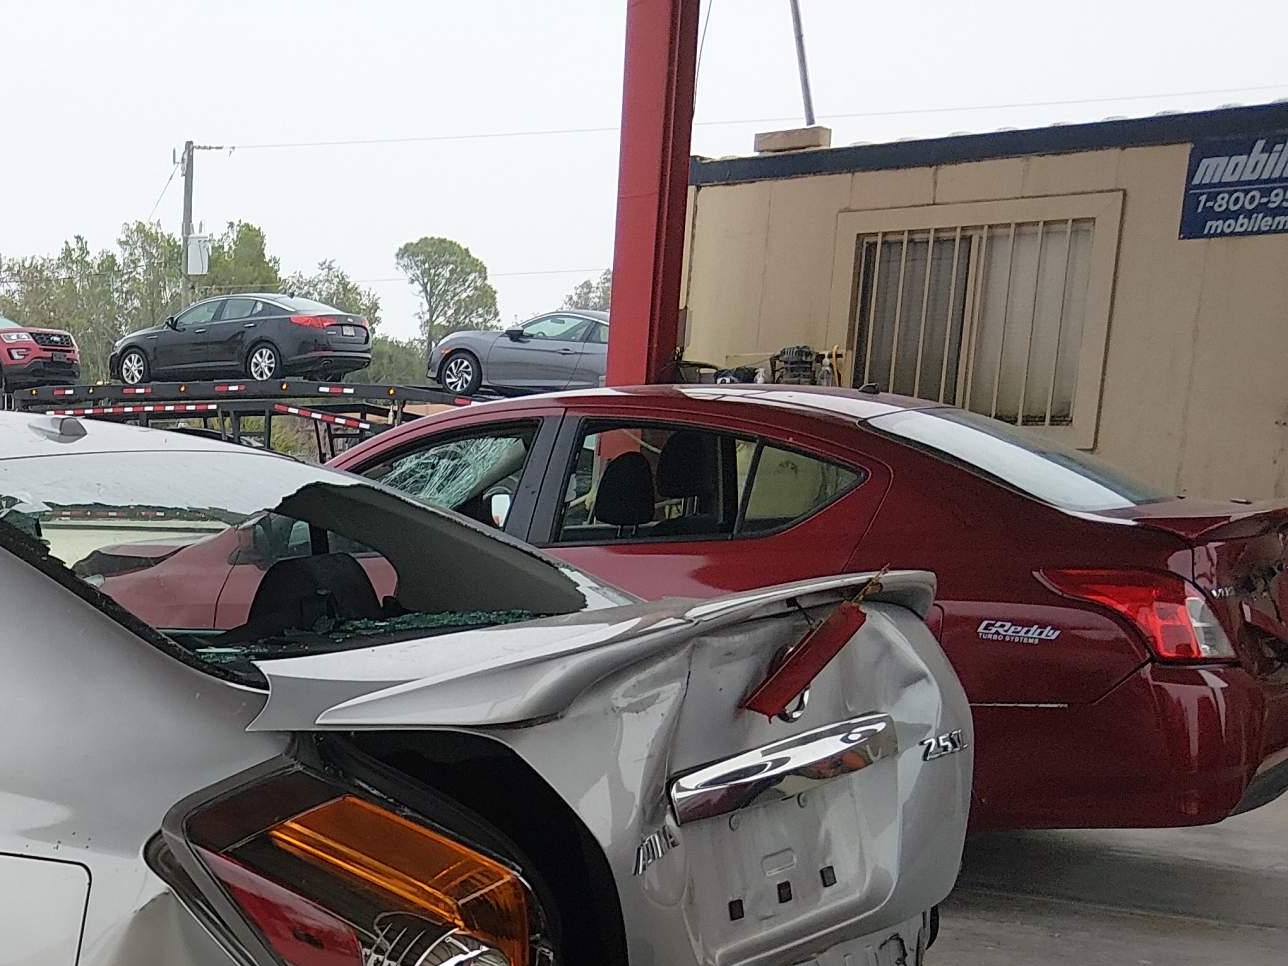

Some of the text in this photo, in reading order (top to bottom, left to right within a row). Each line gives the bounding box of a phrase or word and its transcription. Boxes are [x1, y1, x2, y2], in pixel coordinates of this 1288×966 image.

[975, 619, 1062, 640] GReddy
[978, 633, 1039, 645] TURBO SYSTEMS
